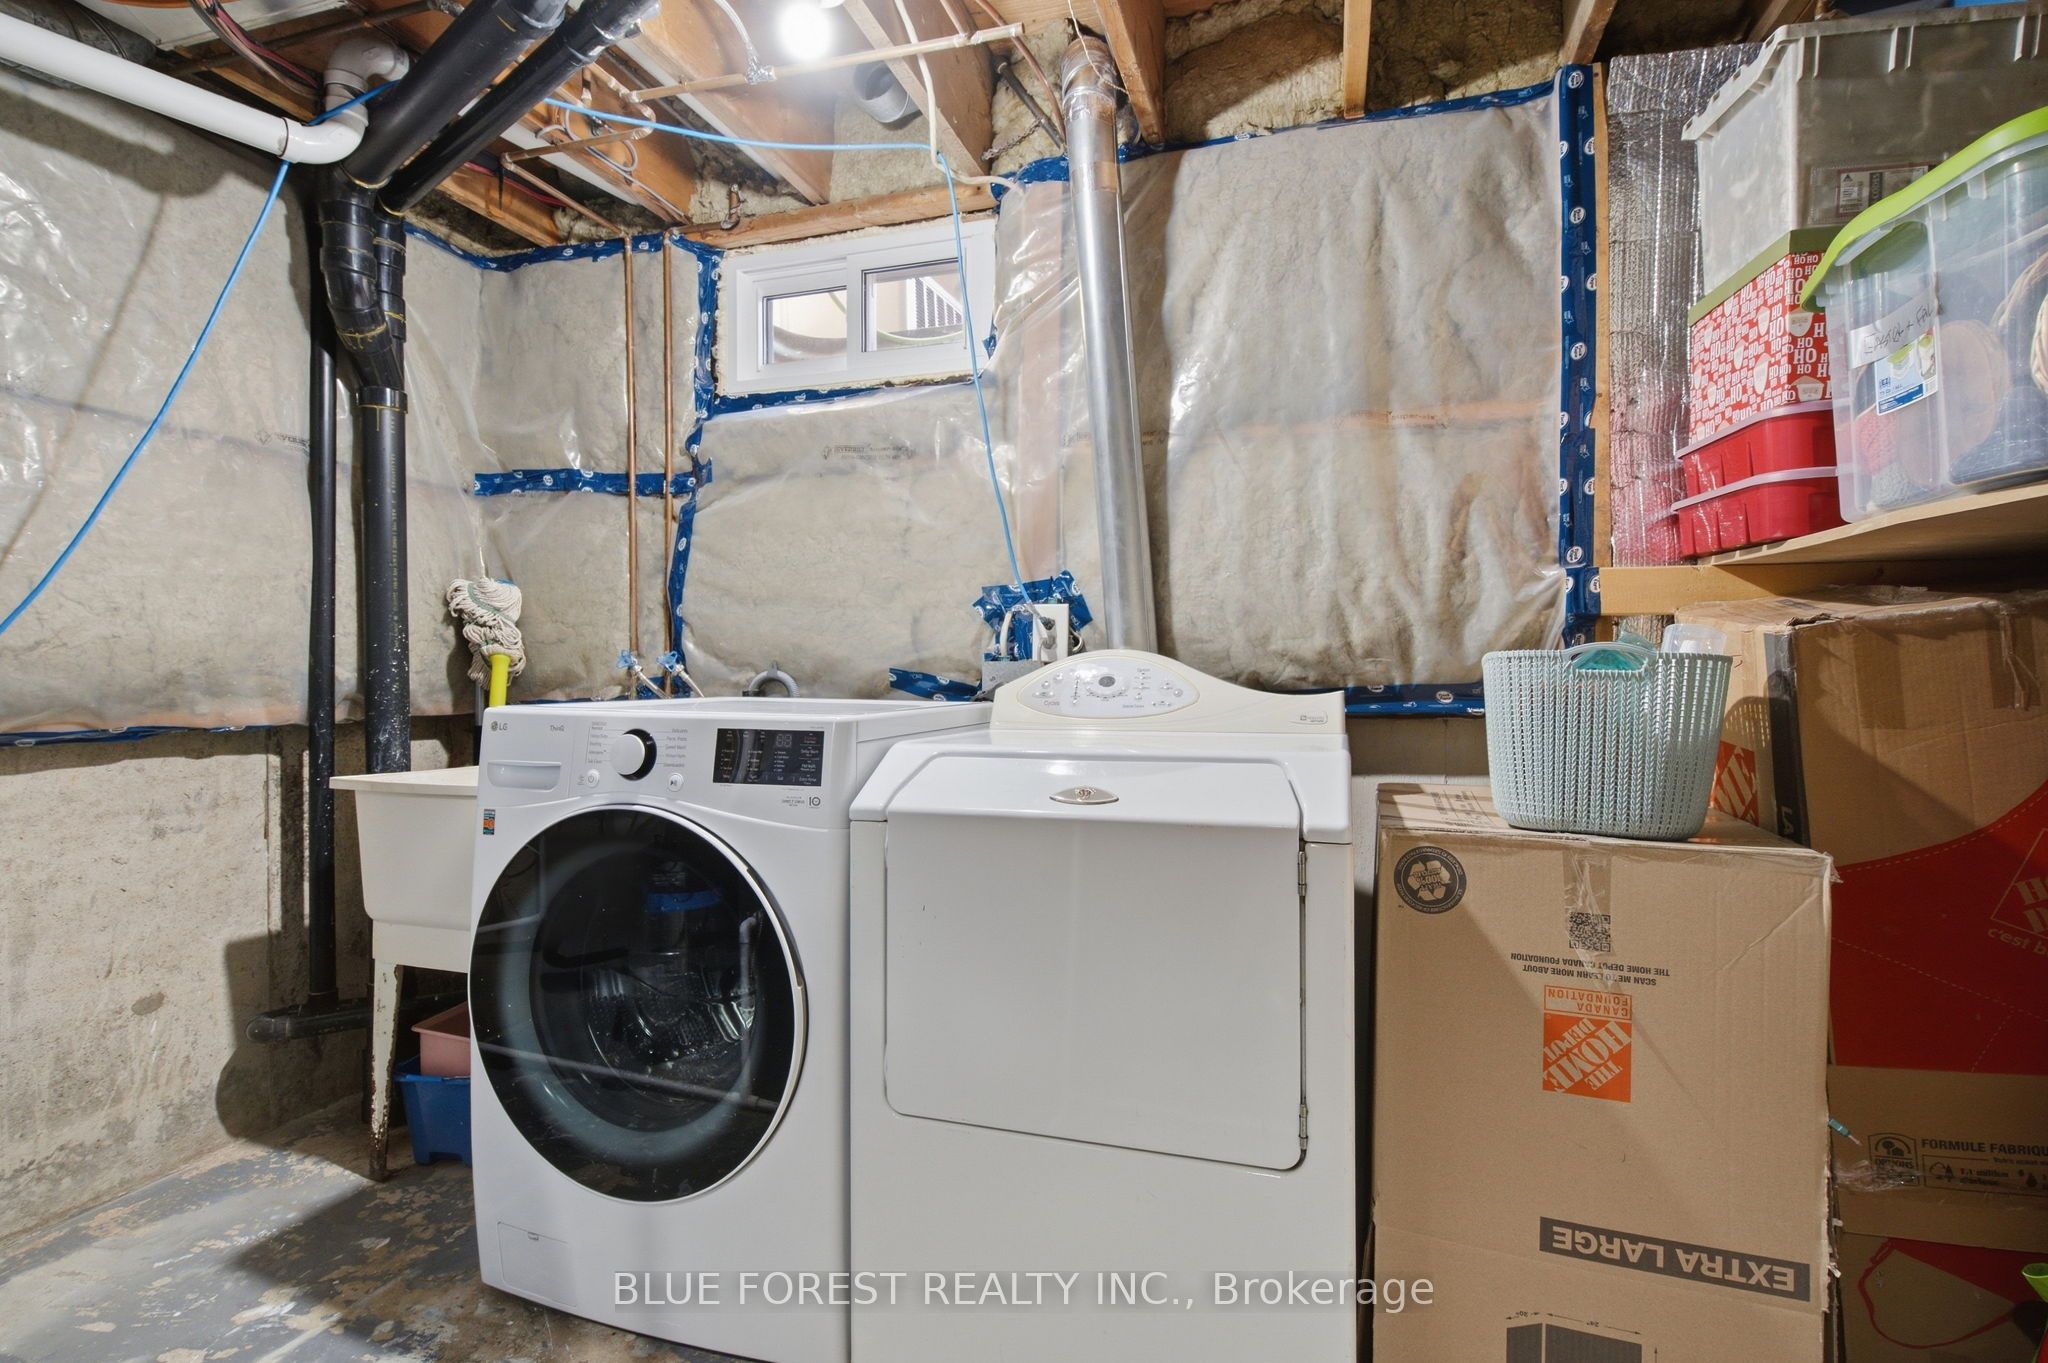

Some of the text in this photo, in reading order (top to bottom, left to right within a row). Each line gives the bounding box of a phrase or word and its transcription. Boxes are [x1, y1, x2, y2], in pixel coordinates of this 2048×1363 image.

[1797, 337, 1813, 349] HO
[1793, 348, 1817, 364] HO
[1797, 364, 1812, 374] HO
[499, 723, 508, 731] LG
[1511, 952, 1560, 965] FOUNDATION
[1522, 964, 1549, 974] ABOUT
[1550, 967, 1574, 976] MORE
[1627, 965, 1650, 975] HOME
[1654, 968, 1670, 976] THE
[1618, 975, 1631, 983] ME
[1633, 977, 1657, 986] SCAN
[1547, 988, 1628, 1007] FOUNDATION
[1577, 1002, 1628, 1017] CANADA
[1543, 1018, 1597, 1062] DEPOT
[1543, 1020, 1632, 1093] HOME
[1584, 1060, 1623, 1090] THE
[1921, 1138, 1986, 1153] FORMULE
[1552, 1225, 1794, 1292] EXTRA LARGE
